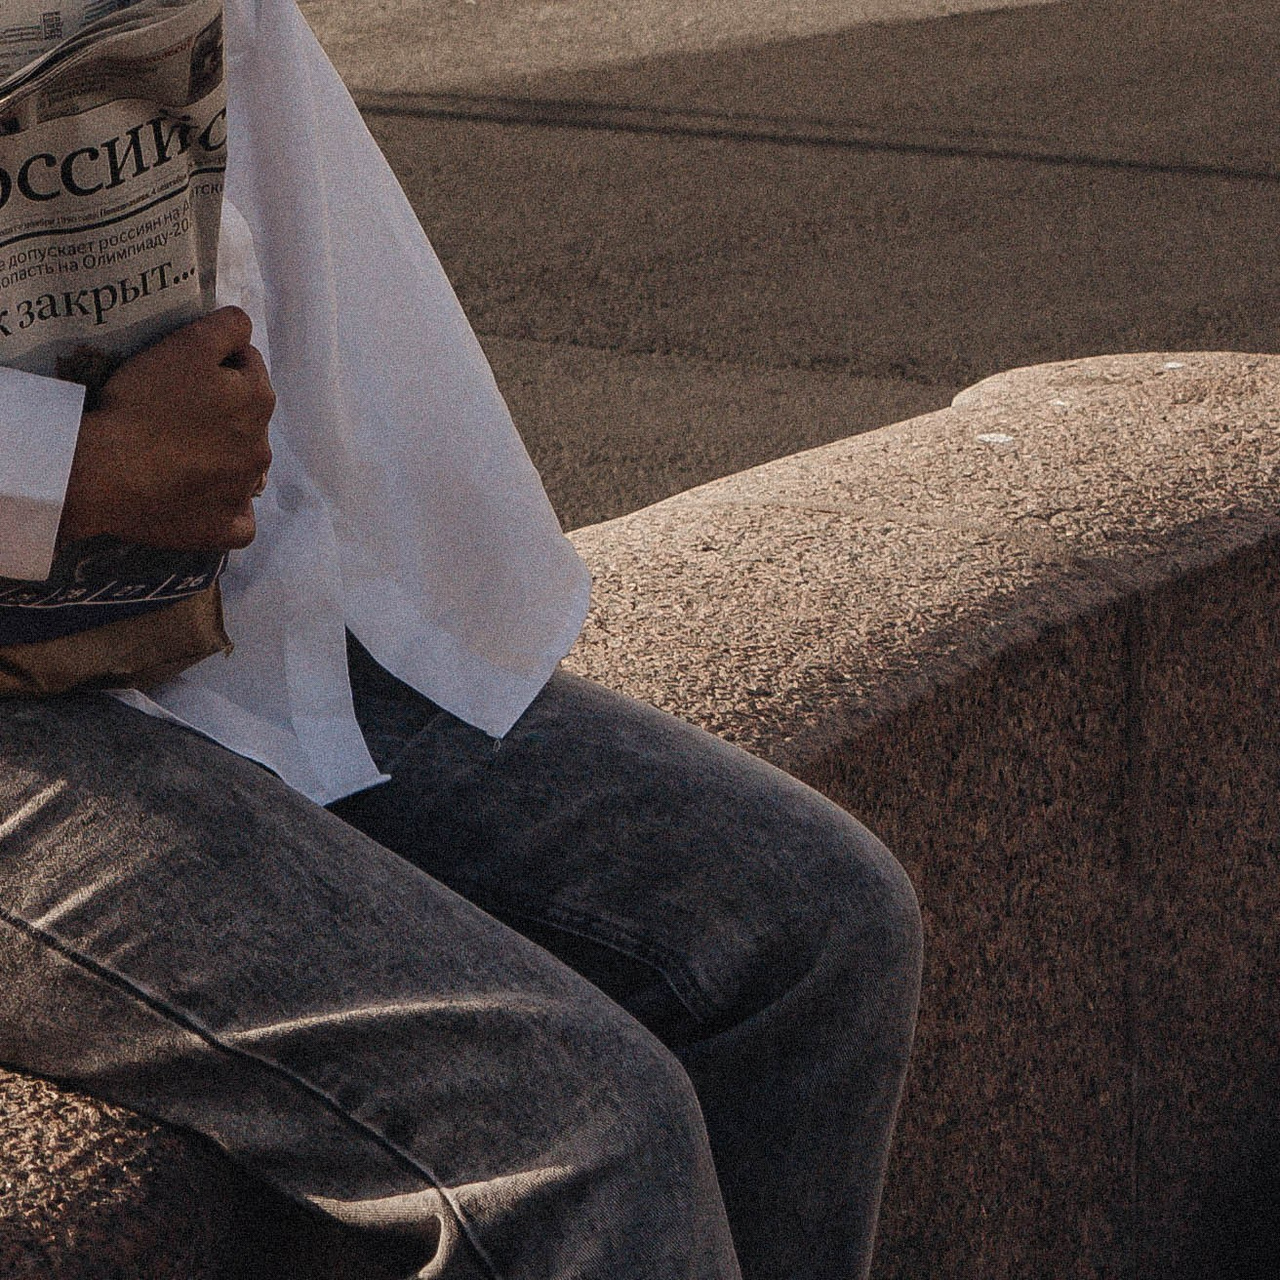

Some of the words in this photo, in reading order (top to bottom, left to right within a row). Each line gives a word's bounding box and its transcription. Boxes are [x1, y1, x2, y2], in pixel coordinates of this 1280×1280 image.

[8, 240, 94, 270] допускает
[99, 216, 163, 251] россиян
[163, 207, 180, 227] на
[58, 258, 79, 274] на
[15, 261, 196, 330] закрыт...
